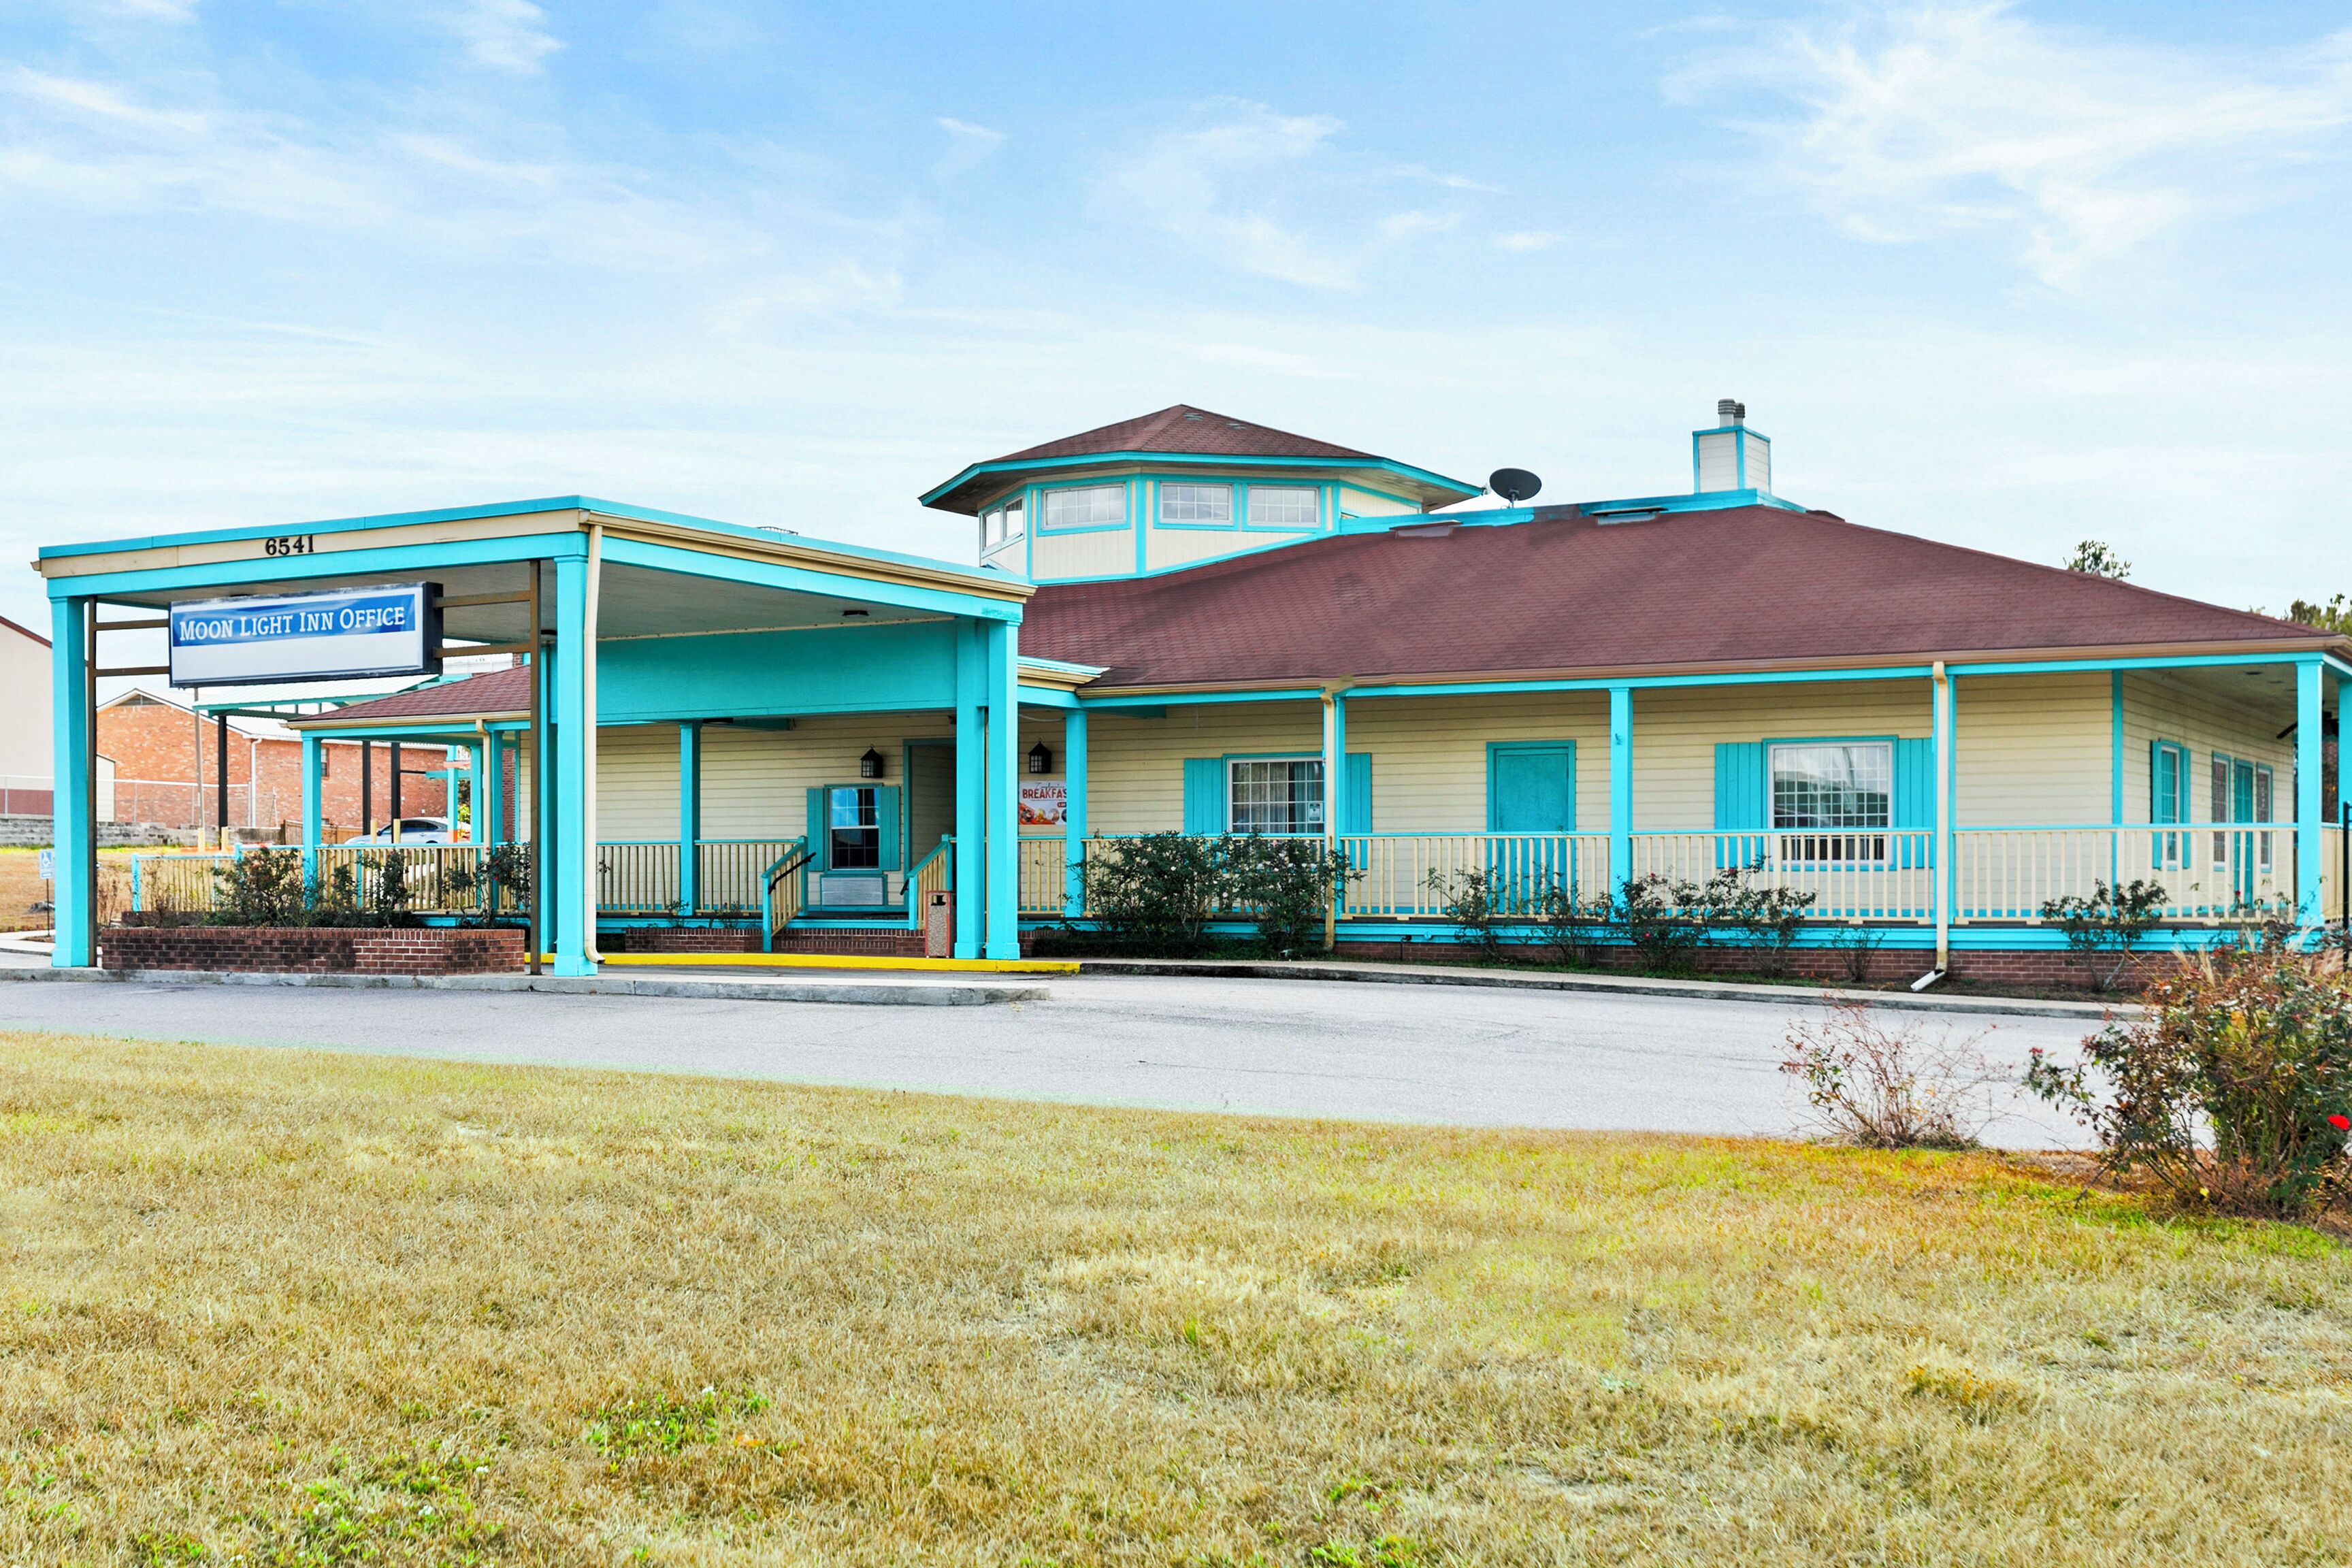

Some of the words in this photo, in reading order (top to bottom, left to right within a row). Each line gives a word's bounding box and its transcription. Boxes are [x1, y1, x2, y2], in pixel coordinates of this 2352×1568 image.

[265, 534, 314, 555] 6541
[180, 620, 234, 641] MOON
[240, 615, 293, 636] LIGHT
[299, 612, 334, 632] INN
[340, 606, 406, 630] OFFICE
